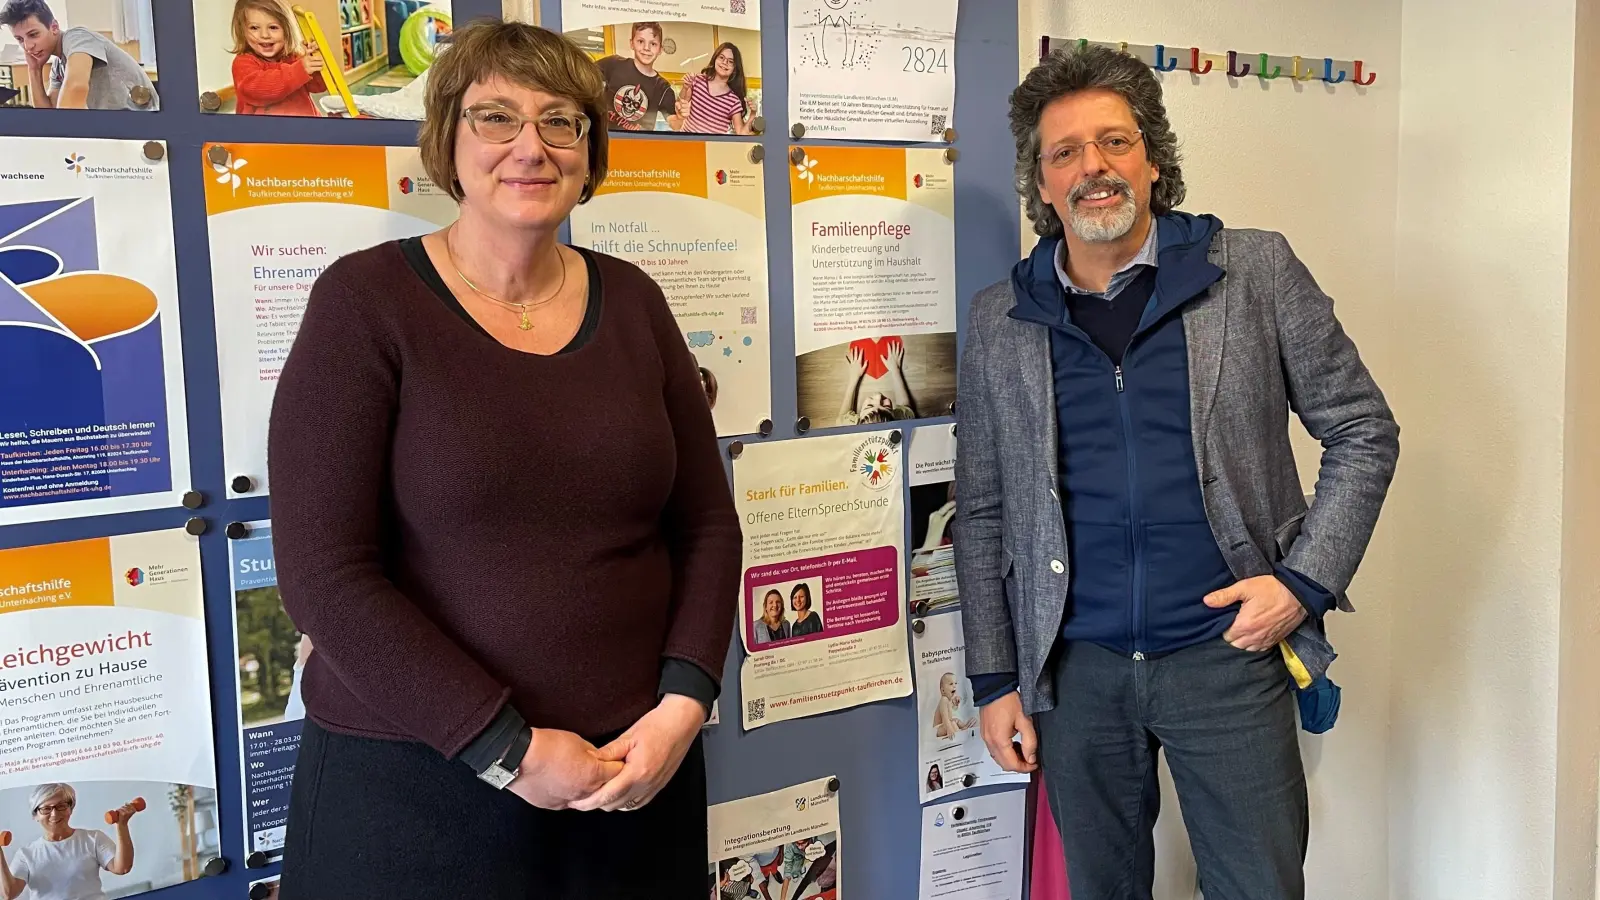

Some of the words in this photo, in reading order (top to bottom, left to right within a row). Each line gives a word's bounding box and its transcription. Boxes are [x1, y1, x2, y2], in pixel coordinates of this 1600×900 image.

[902, 46, 948, 74] 2824
[85, 166, 153, 174] Nachbarschaftshilfe
[247, 176, 354, 188] Nachbarschaftshilfe
[817, 174, 884, 183] Nachbarschaftshilfe
[292, 190, 342, 198] Unterhaching
[592, 222, 606, 233] Im
[609, 222, 648, 233] Notfall
[812, 220, 910, 240] Familienpflege
[252, 245, 274, 256] Wir
[278, 244, 327, 256] suchen:
[592, 240, 620, 253] hilft
[624, 240, 644, 252] die
[648, 238, 738, 256] Schnupfenfee!
[812, 244, 882, 255] Kinderbetreuung
[884, 244, 900, 252] und
[812, 258, 872, 269] Unterstützung
[874, 258, 884, 266] im
[886, 257, 921, 266] Haushalt
[0, 432, 28, 441] Lesen,
[30, 429, 73, 438] Schreiben
[94, 424, 128, 432] Deutsch
[130, 422, 156, 430] lernen
[1, 450, 42, 459] Taufkirchen:
[66, 446, 88, 454] Freitag
[850, 435, 899, 473] Familienstützpunkt
[2, 466, 48, 476] Unterhaching:
[66, 480, 100, 488] Anmeldung
[746, 488, 776, 502] Stark
[780, 486, 796, 497] für
[800, 480, 848, 494] Familien.
[746, 510, 784, 524] Offene
[788, 496, 890, 519] ElternSprechStunde
[148, 566, 188, 576] Generationen
[0, 630, 152, 670] eichgewicht
[927, 656, 952, 664] Taufkirchen
[76, 668, 94, 679] zu
[100, 658, 148, 675] Hause
[0, 692, 56, 708] Menschen
[59, 688, 80, 698] und
[84, 672, 163, 694] Ehrenamtliche
[770, 676, 904, 709] www.familienstuetzpunkt-taufkirchen.de
[21, 712, 61, 722] Programm
[62, 706, 92, 716] umfasst
[114, 692, 164, 706] Hausbesuche
[3, 720, 64, 736] Ehrenamtlichen,
[66, 716, 79, 724] die
[108, 703, 156, 716] individuellen
[24, 730, 57, 741] anleiten.
[59, 727, 78, 735] Oder
[80, 720, 112, 731] möchten
[249, 730, 274, 740] Wann
[26, 738, 66, 750] Programm
[68, 728, 114, 742] teilnehmen?
[250, 742, 269, 750] 17.01.
[250, 748, 270, 757] immer
[272, 744, 296, 754] freitags
[250, 762, 264, 770] Wo
[252, 774, 294, 787] Unterhaching
[252, 782, 284, 794] Ahornring
[252, 798, 270, 808] Wer
[252, 809, 270, 818] Jeder
[724, 824, 792, 846] Integrationsberatung
[790, 826, 810, 836] Landkreis
[810, 822, 830, 830] München
